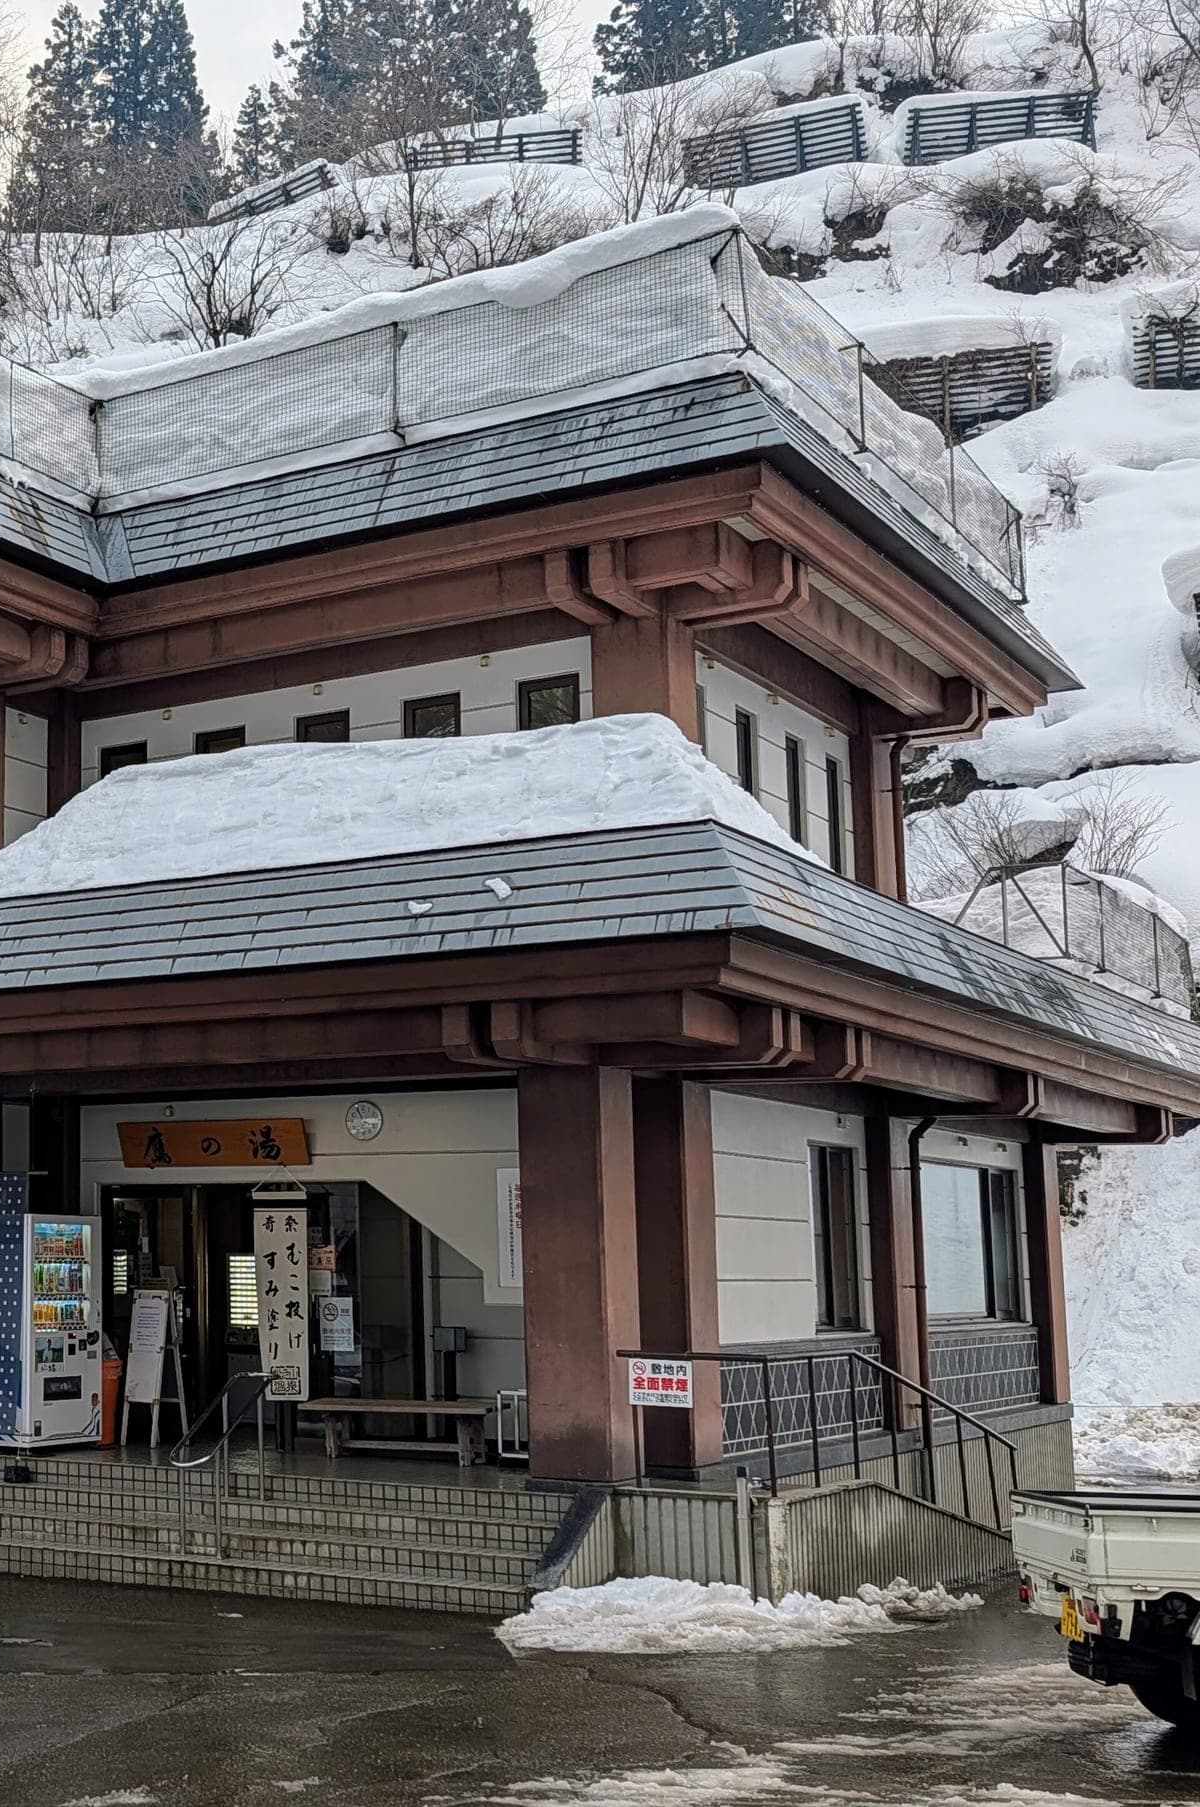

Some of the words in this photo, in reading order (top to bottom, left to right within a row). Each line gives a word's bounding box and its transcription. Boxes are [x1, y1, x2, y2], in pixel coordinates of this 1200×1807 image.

[143, 1125, 282, 1165] 鷹の湯
[651, 1363, 687, 1376] 敷地内
[633, 1376, 688, 1392] 全面禁煙
